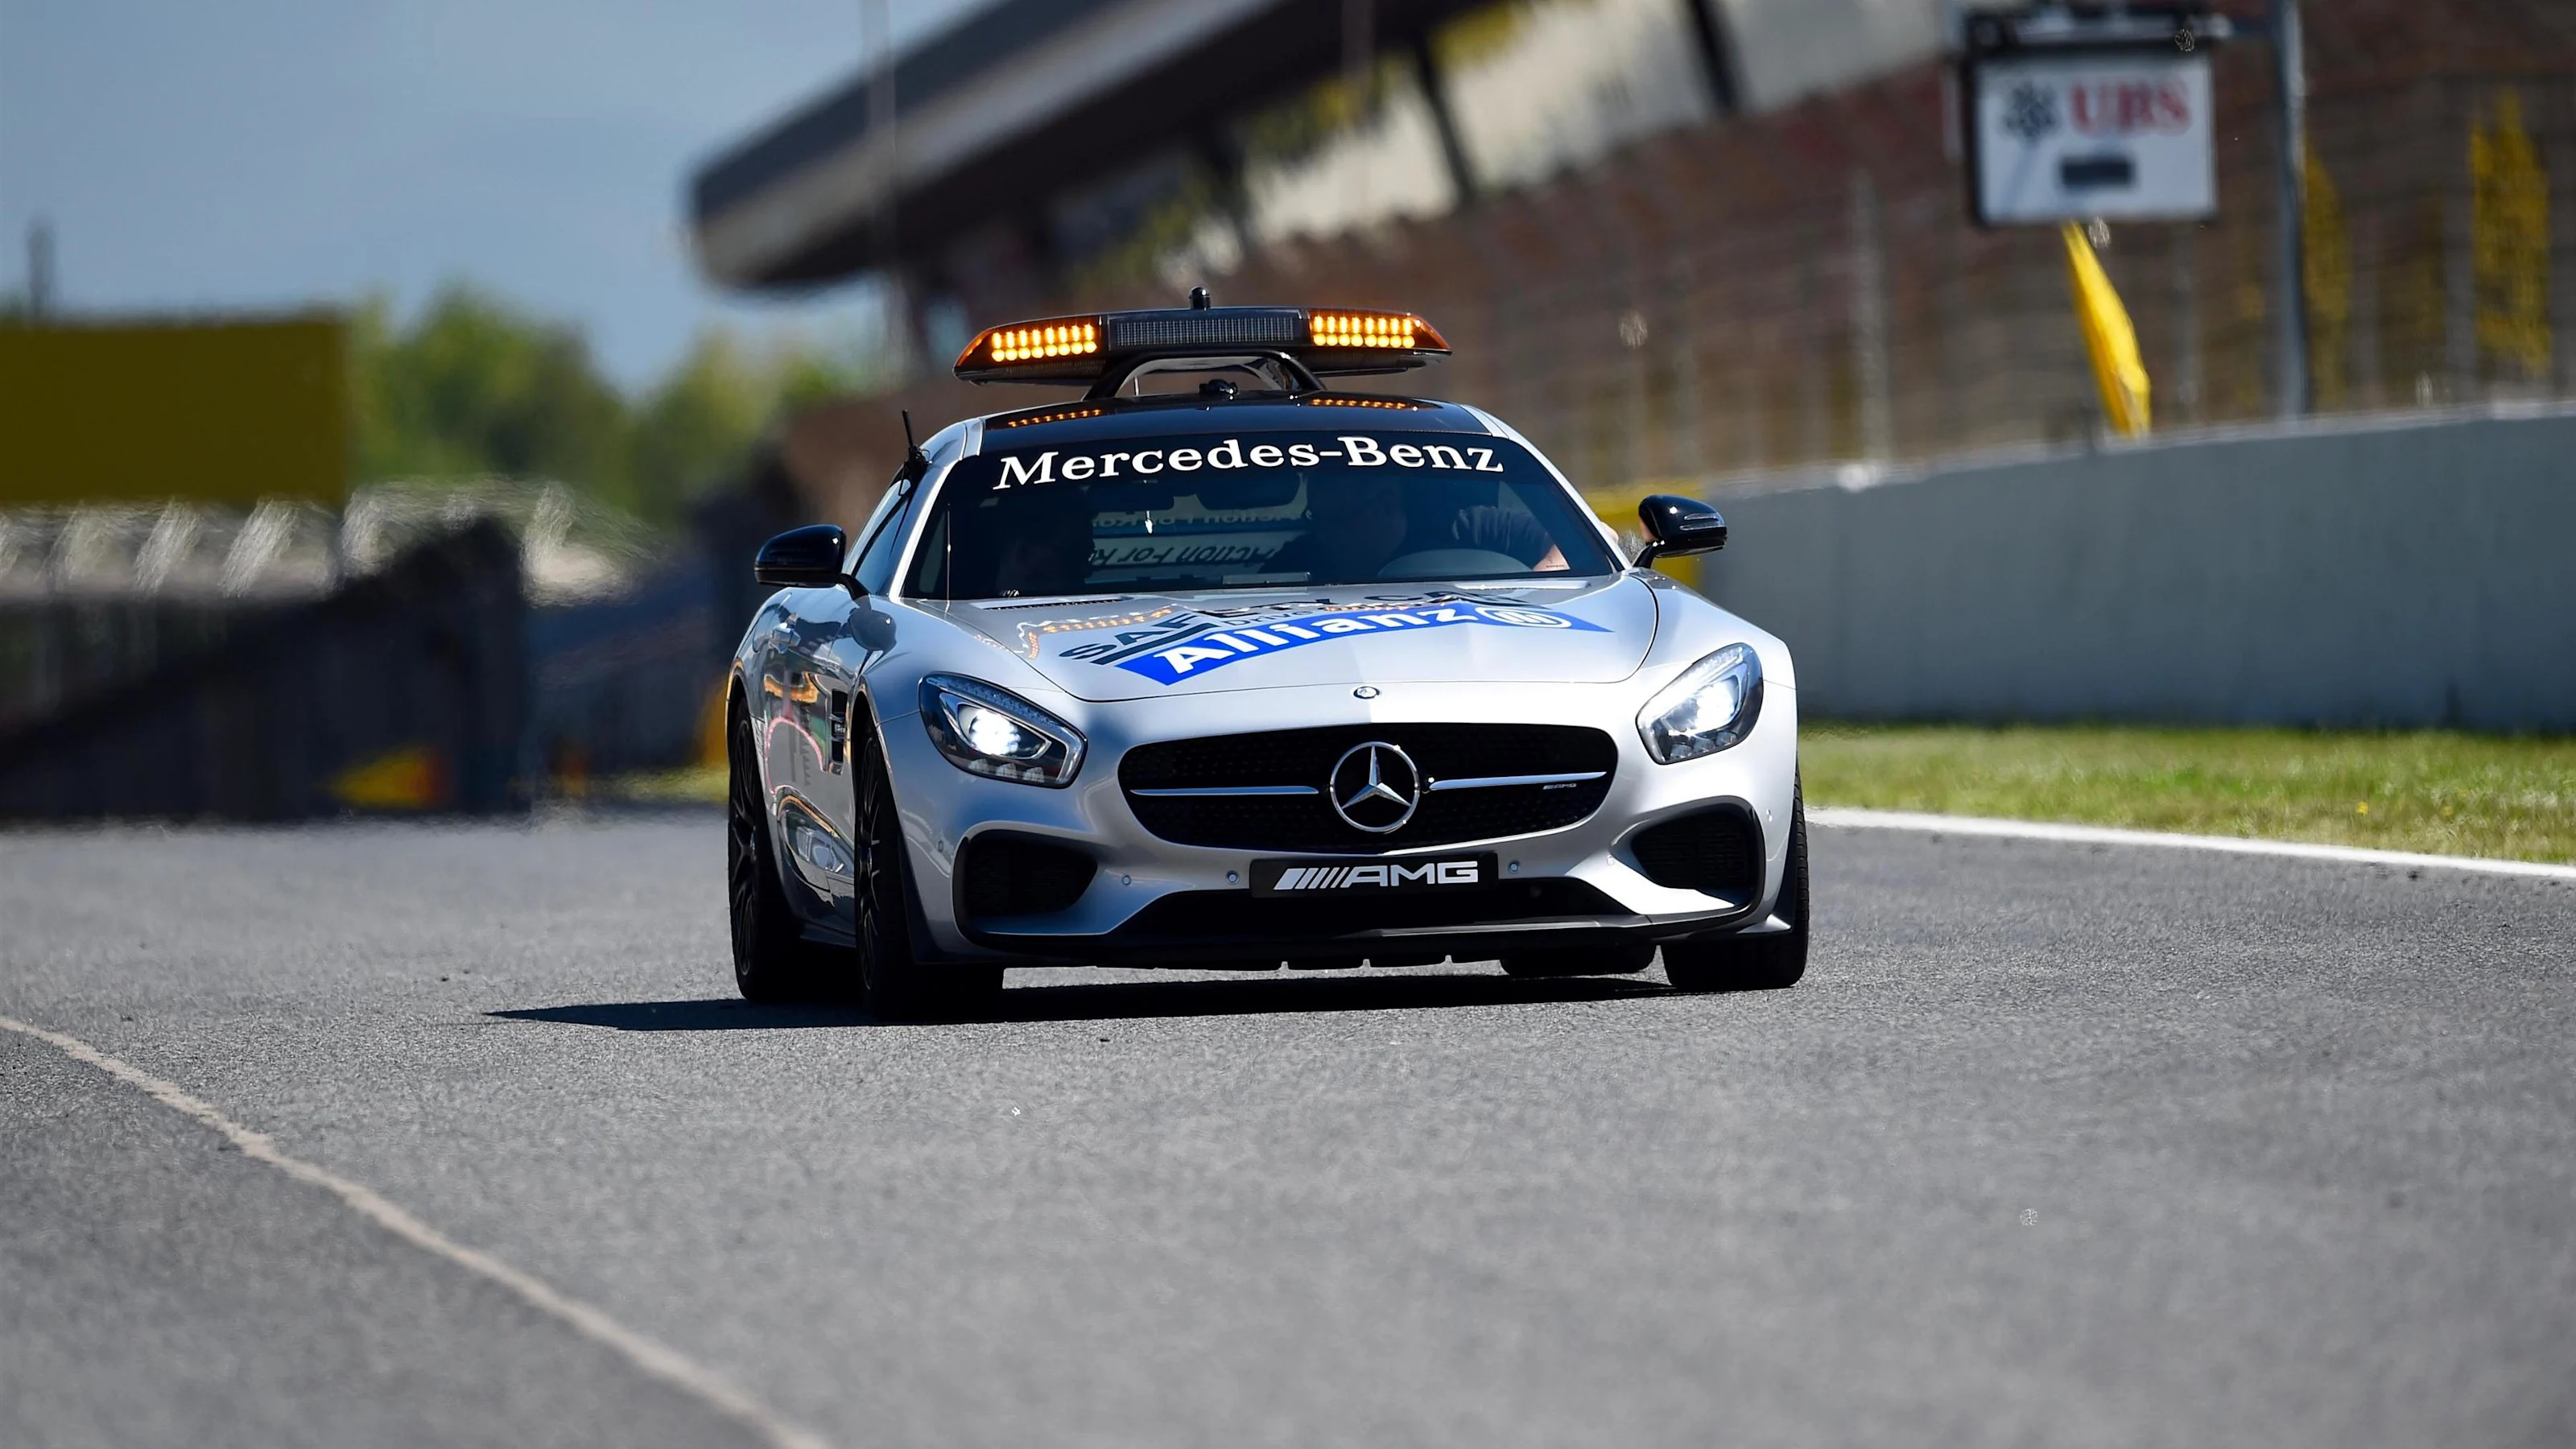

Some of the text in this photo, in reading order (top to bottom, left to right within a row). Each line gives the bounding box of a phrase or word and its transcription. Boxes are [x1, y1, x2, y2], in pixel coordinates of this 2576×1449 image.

[2069, 81, 2191, 134] UBS
[993, 436, 1503, 489] Mercedes-Benz
[1154, 608, 1479, 675] Allianz
[1340, 861, 1479, 888] AMG
